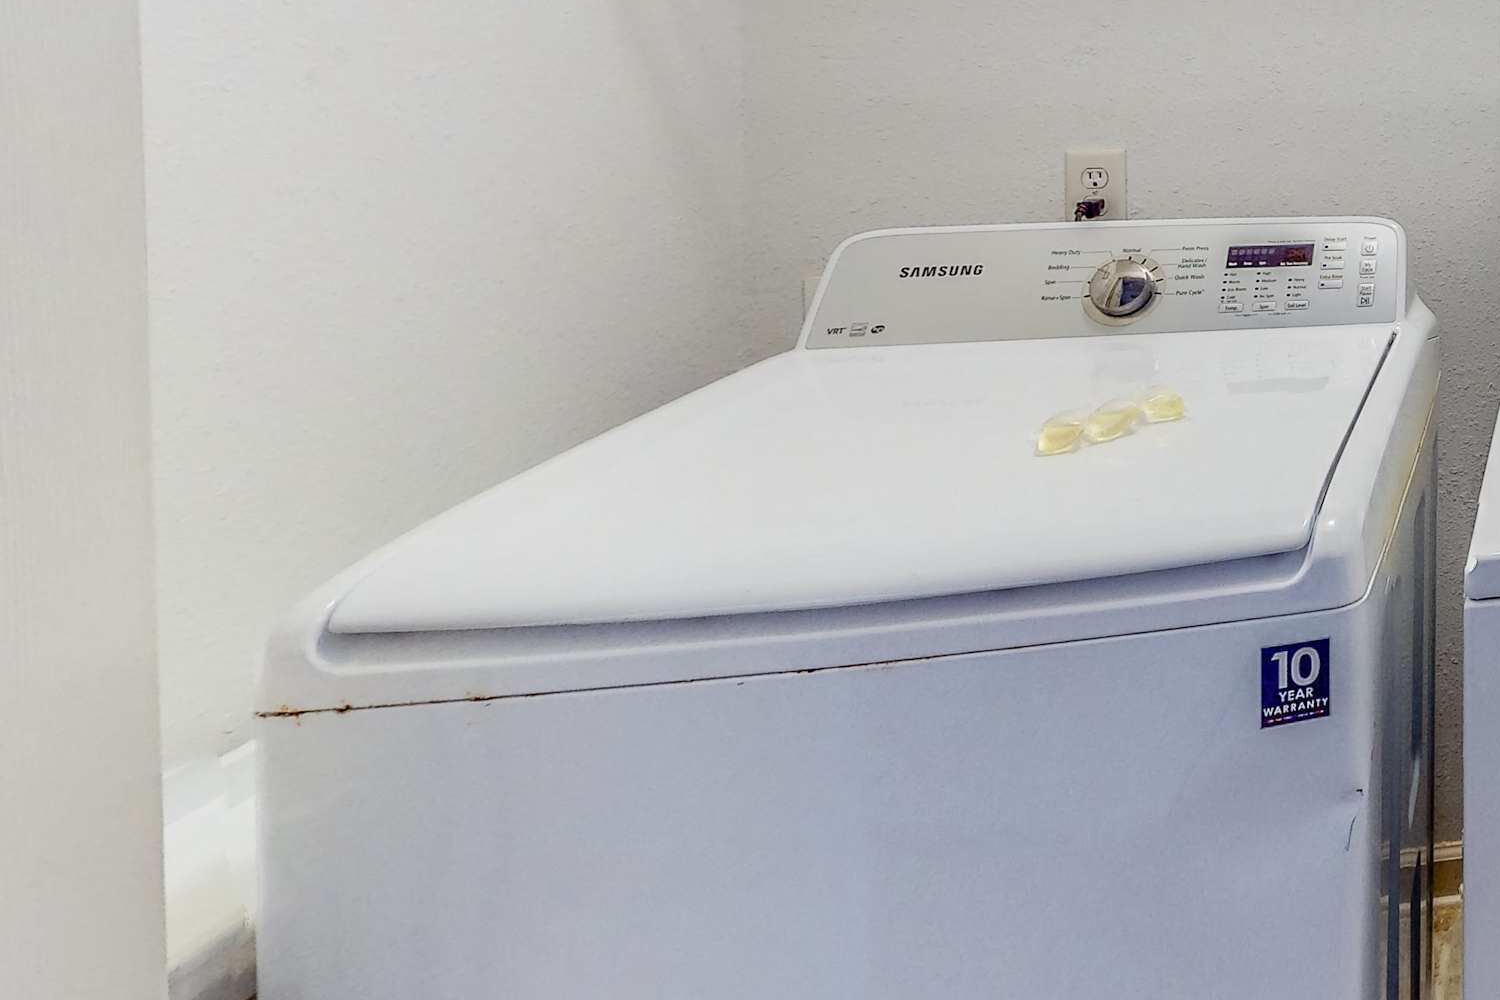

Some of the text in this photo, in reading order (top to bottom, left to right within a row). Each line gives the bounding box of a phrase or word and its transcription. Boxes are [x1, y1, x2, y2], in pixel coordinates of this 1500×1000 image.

[899, 264, 984, 278] SAMSUNG
[1271, 647, 1320, 690] 10
[1278, 687, 1314, 702] YEAR
[1263, 697, 1328, 717] WARRANTY
